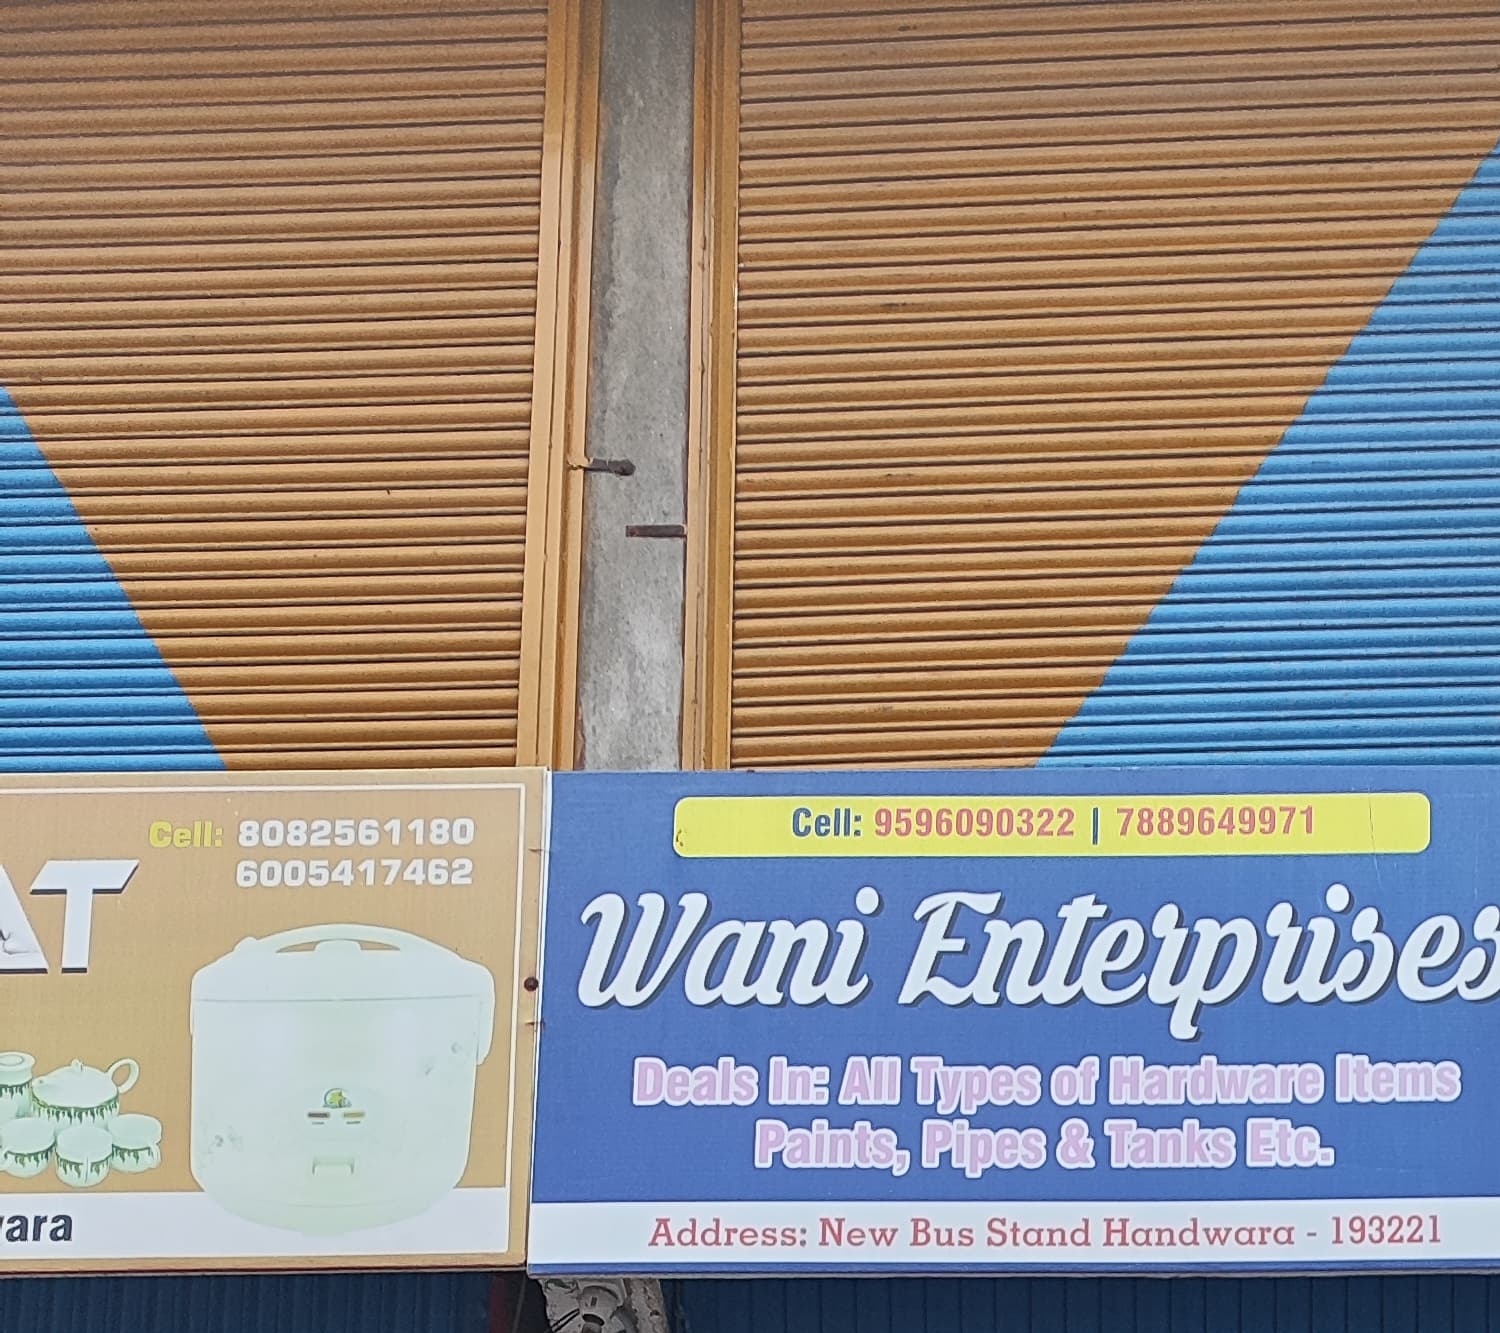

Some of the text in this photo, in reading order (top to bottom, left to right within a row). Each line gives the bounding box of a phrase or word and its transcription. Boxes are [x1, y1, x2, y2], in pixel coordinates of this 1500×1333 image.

[149, 817, 475, 848] Cell: 8082561180
[792, 805, 1316, 838] Cell: 9596090322 7889649971
[236, 858, 473, 888] 6005417462
[579, 885, 882, 1010] Wani
[633, 1052, 1461, 1115] Deals In: All Types of Hardware Items
[754, 1119, 1335, 1179] Paints, Pipes & Tanks Etc.
[0, 1214, 73, 1242] ara
[648, 1218, 806, 1249] Address:
[818, 1218, 902, 1248] New
[910, 1217, 976, 1248] Bus
[985, 1216, 1091, 1248] Stand
[1102, 1216, 1295, 1248] Handwara
[1331, 1214, 1442, 1246] 193221
